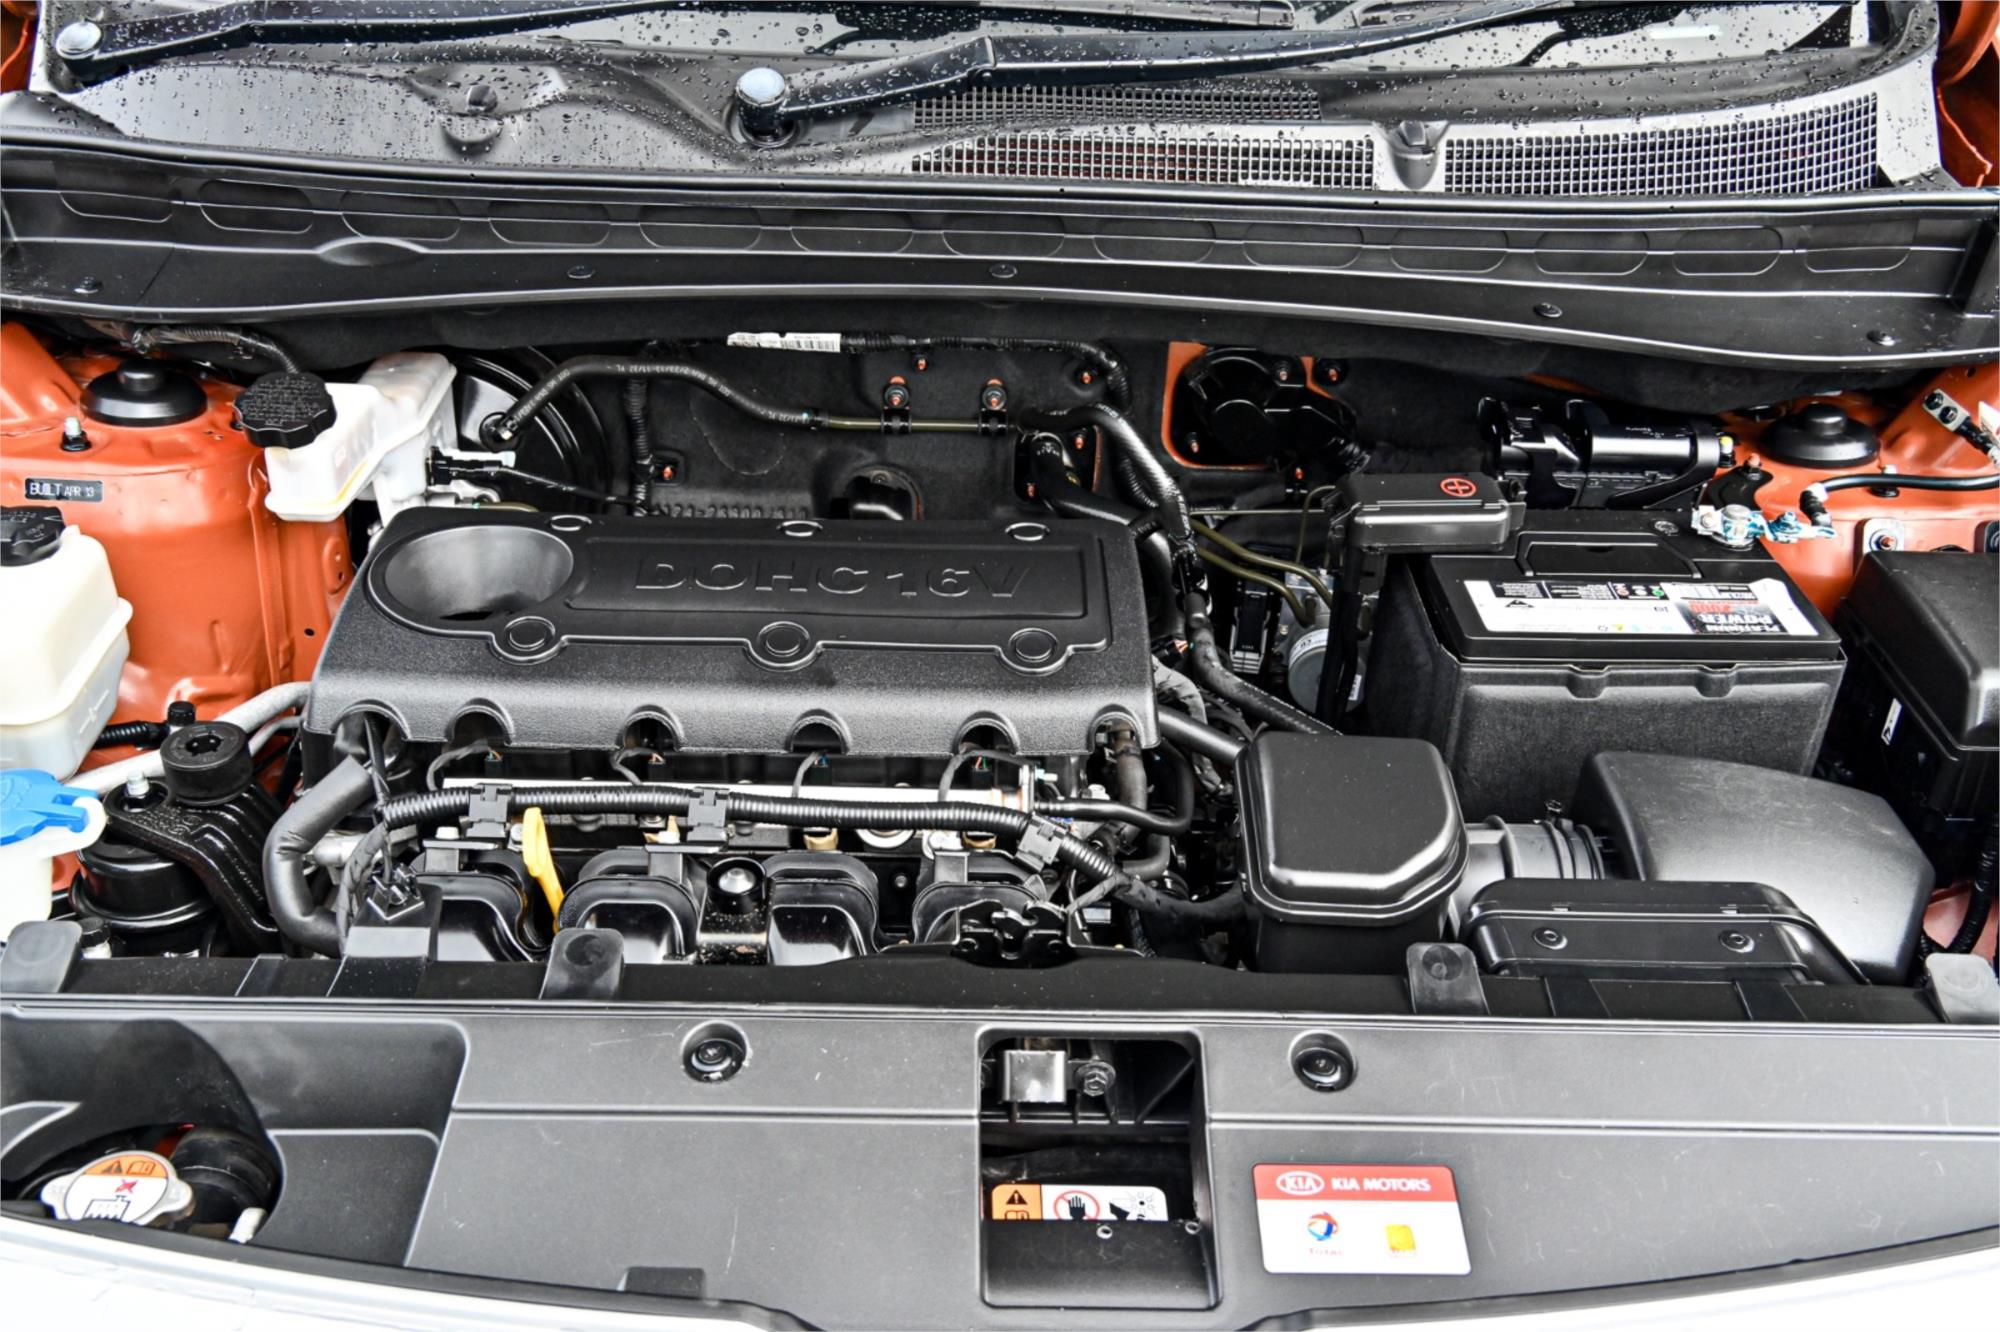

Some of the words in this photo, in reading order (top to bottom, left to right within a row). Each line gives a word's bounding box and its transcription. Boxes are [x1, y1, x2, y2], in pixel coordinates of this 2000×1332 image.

[29, 482, 62, 496] BUILT
[635, 558, 869, 595] DOHC
[886, 563, 1031, 598] 16V
[1697, 613, 1774, 625] POWER
[1285, 1175, 1317, 1191] KIA
[1331, 1177, 1360, 1191] KIA
[1363, 1177, 1432, 1193] MOTORS
